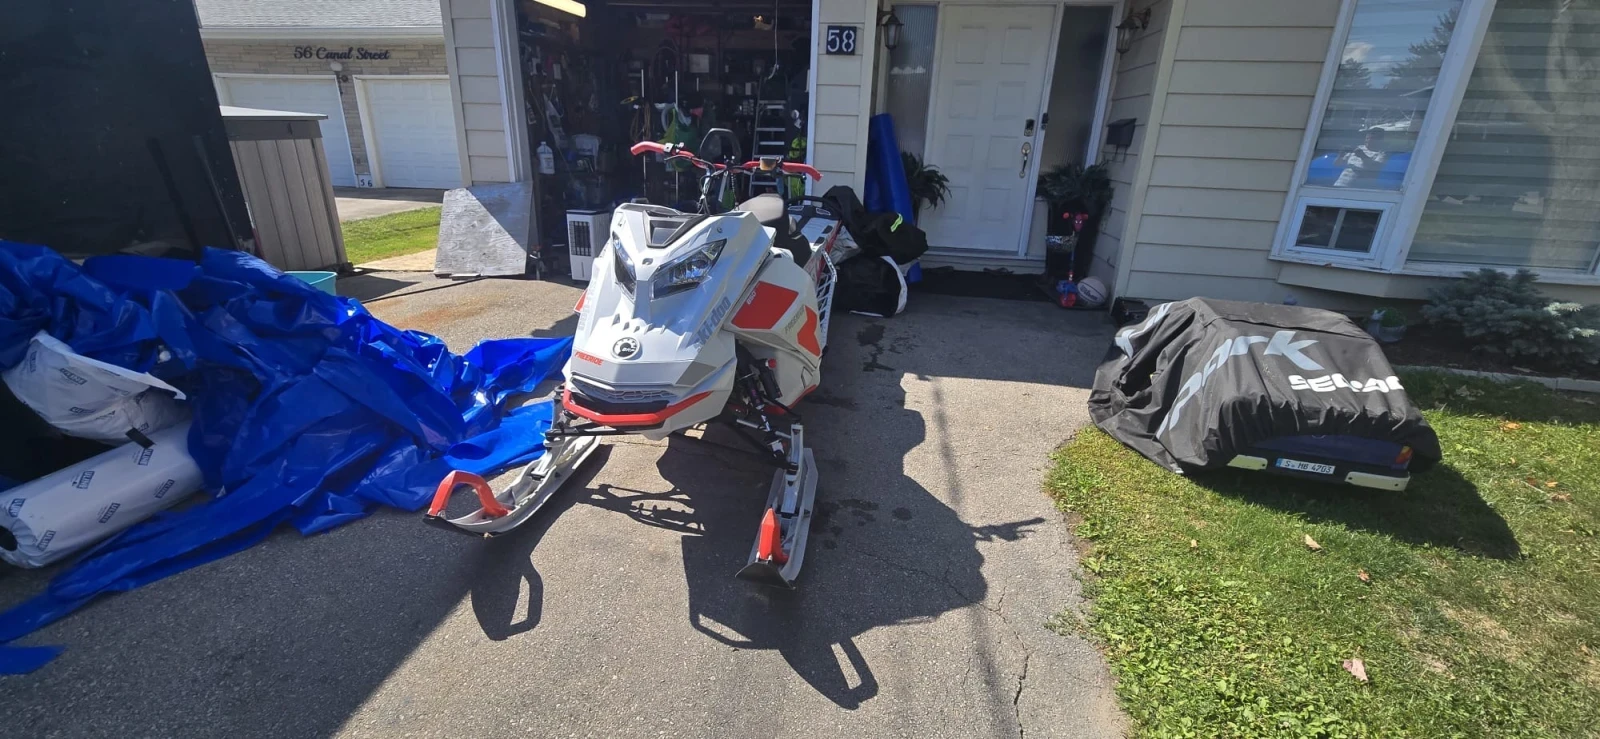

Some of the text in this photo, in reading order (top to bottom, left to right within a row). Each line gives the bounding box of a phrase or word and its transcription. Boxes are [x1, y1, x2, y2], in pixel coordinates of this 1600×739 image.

[827, 29, 855, 52] 58
[294, 46, 389, 60] 56 Canal Street
[574, 351, 604, 366] FREERIDE
[1156, 330, 1325, 439] park
